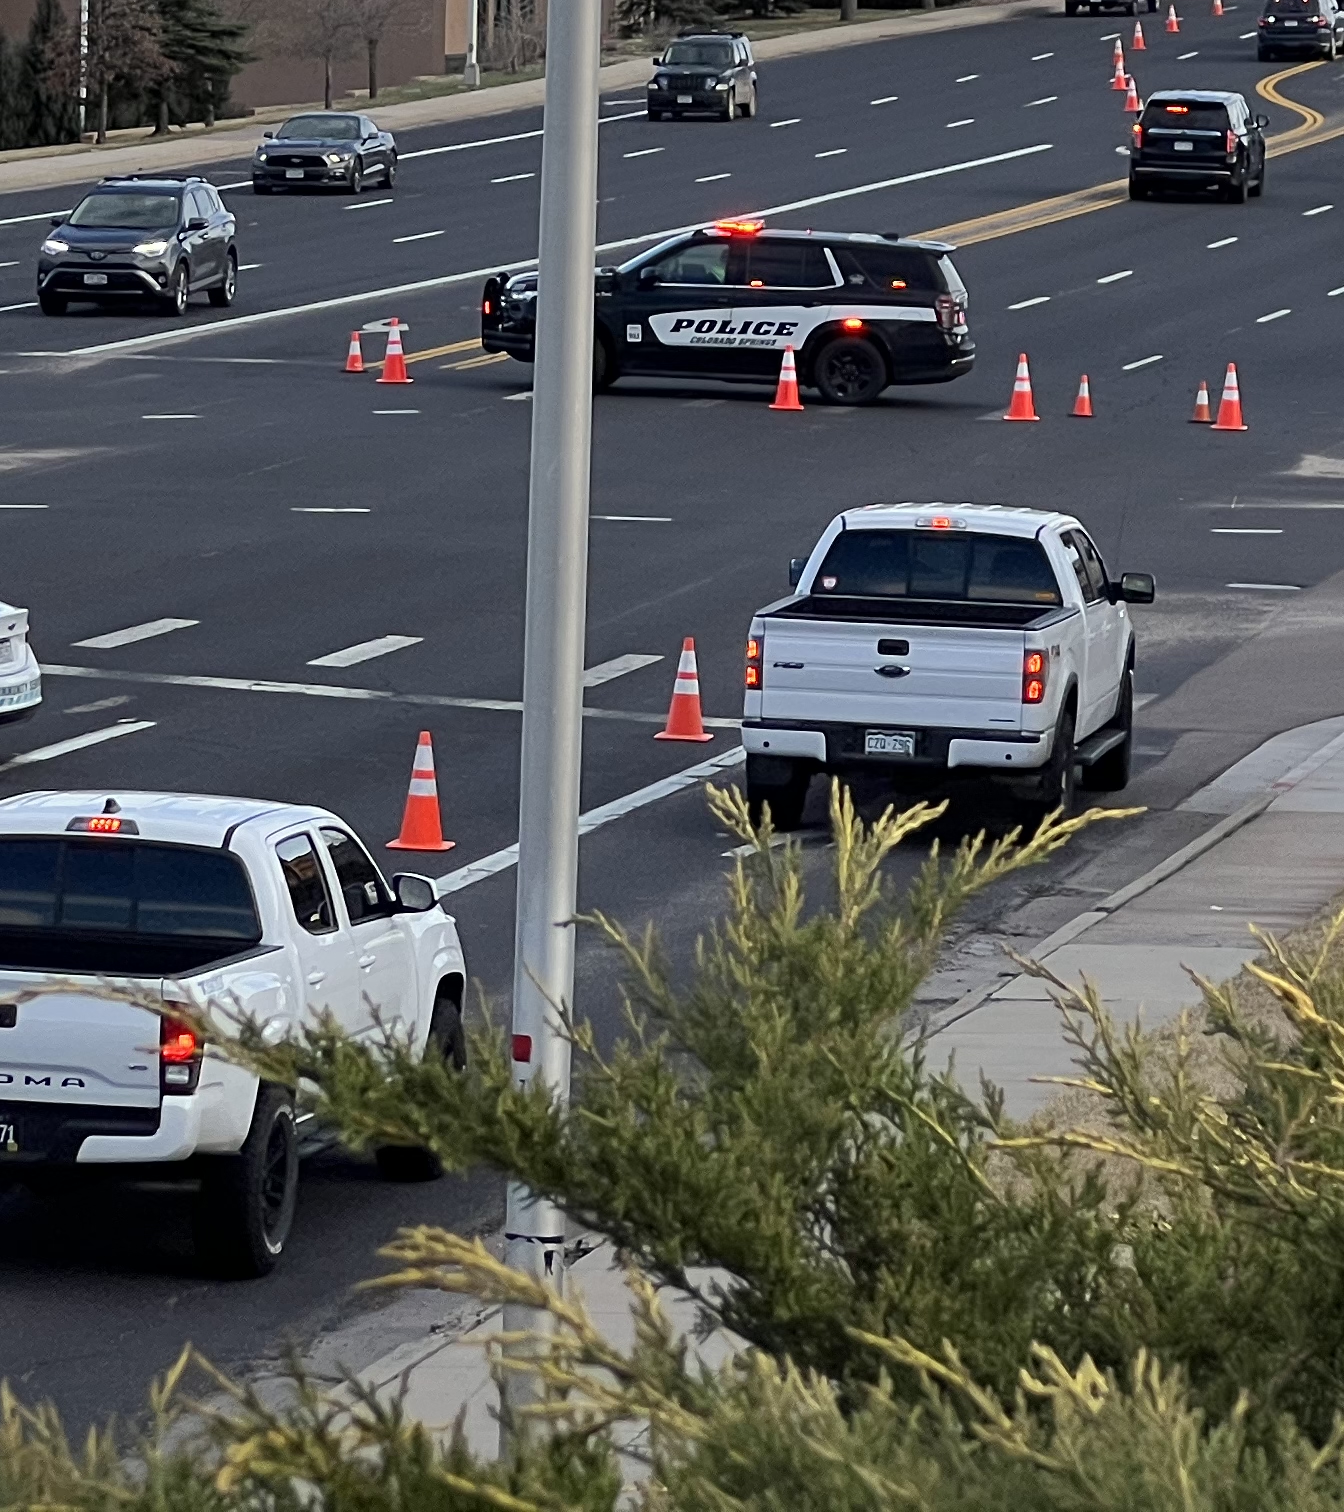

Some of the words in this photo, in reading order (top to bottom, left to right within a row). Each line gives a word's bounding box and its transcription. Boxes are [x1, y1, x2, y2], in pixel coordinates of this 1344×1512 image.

[669, 318, 799, 337] POLICE
[690, 336, 736, 345] COLORADO
[738, 337, 777, 346] SPRINGS
